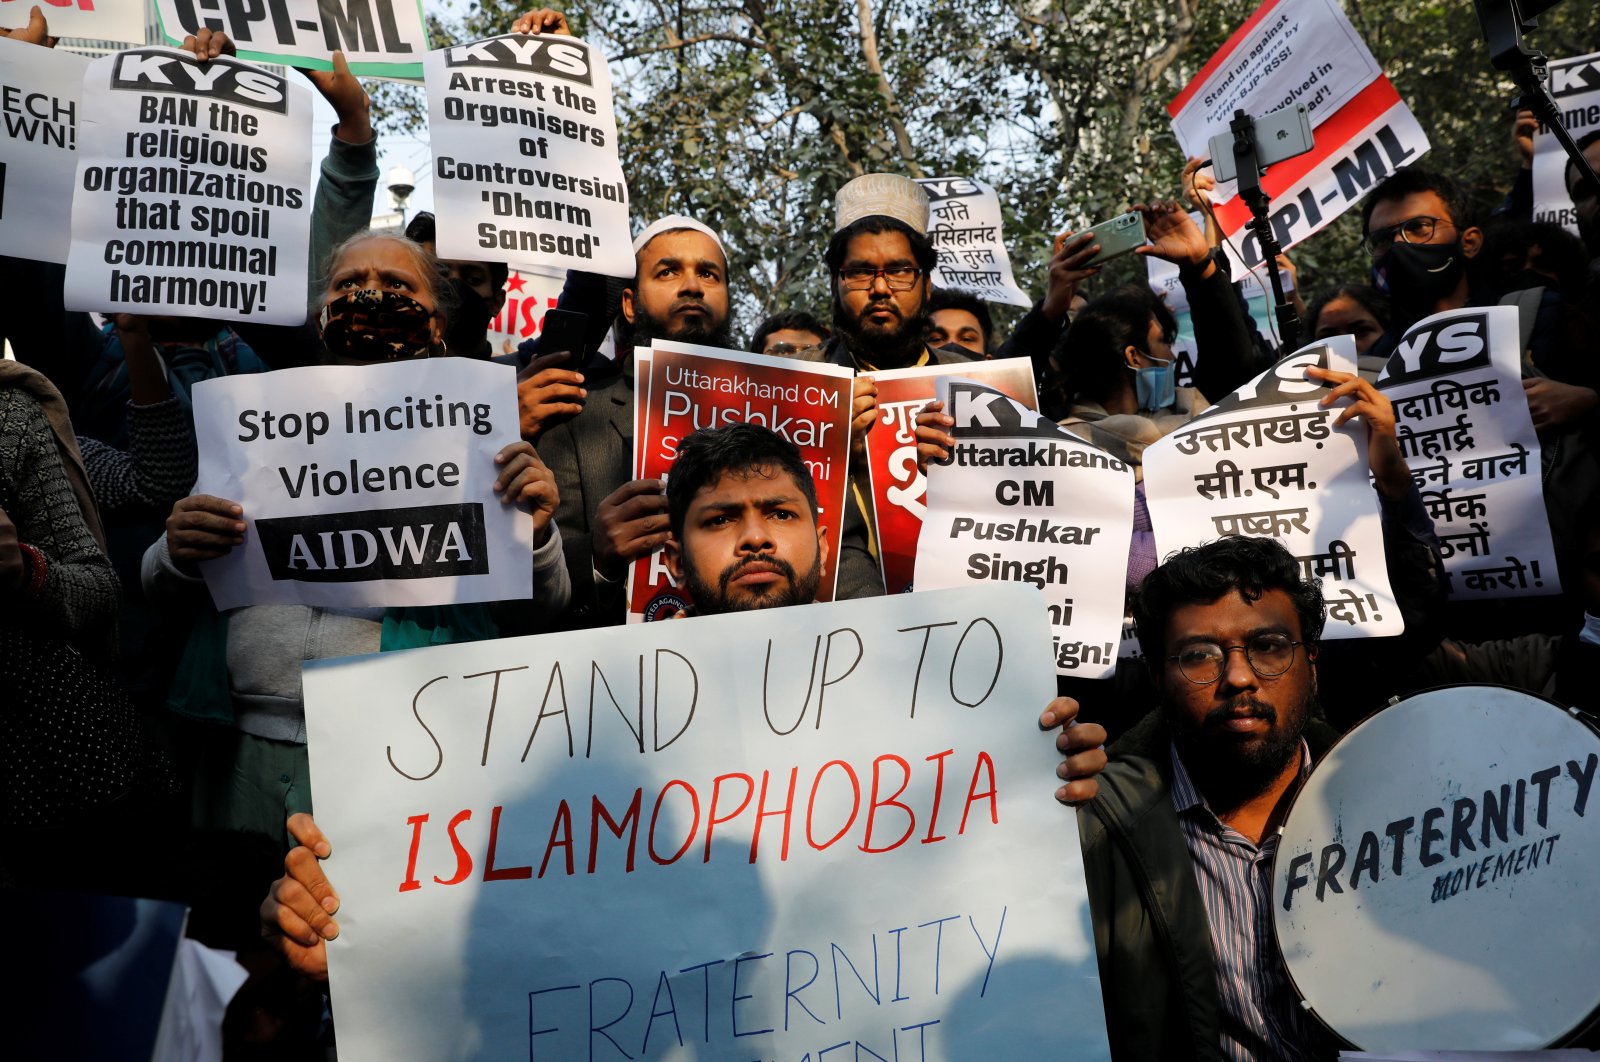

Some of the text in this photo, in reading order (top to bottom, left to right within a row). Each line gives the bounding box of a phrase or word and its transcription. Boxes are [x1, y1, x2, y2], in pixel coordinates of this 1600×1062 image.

[1284, 22, 1299, 39] by
[118, 54, 285, 104] KYS
[451, 38, 588, 77] KYS
[1204, 15, 1289, 107] Stand up against
[1316, 62, 1333, 77] in
[448, 72, 597, 115] Arrest the
[1216, 46, 1293, 122] VHP-BJP-RSS!
[139, 95, 258, 136] BAN the
[444, 97, 605, 147] Organisers
[126, 129, 267, 173] religious
[519, 137, 548, 160] of
[83, 164, 303, 209] organizations
[437, 156, 625, 204] Controversial
[922, 180, 978, 197] YS
[116, 198, 269, 239] that spoil
[481, 190, 592, 227] 'Dharm
[932, 200, 970, 221] यति
[104, 239, 277, 276] communal
[477, 222, 600, 260] Sansad'
[110, 269, 267, 314] harmony!
[666, 366, 838, 409] Uttarakhand CM
[238, 394, 493, 445] Stop Inciting
[278, 459, 460, 499] Violence
[1462, 443, 1530, 481] वाले
[995, 480, 1055, 507] CM
[287, 521, 473, 570] AIDWA
[949, 517, 1100, 546] Pushkar
[966, 553, 1068, 590] Singh
[386, 616, 1004, 782] STAND UP TO
[398, 749, 1000, 893] ISLAMOPHOBIA
[1282, 752, 1599, 912] FRATERNITY
[1430, 834, 1561, 904] MOVEMENT
[528, 906, 1008, 1062] FRATERNITY
